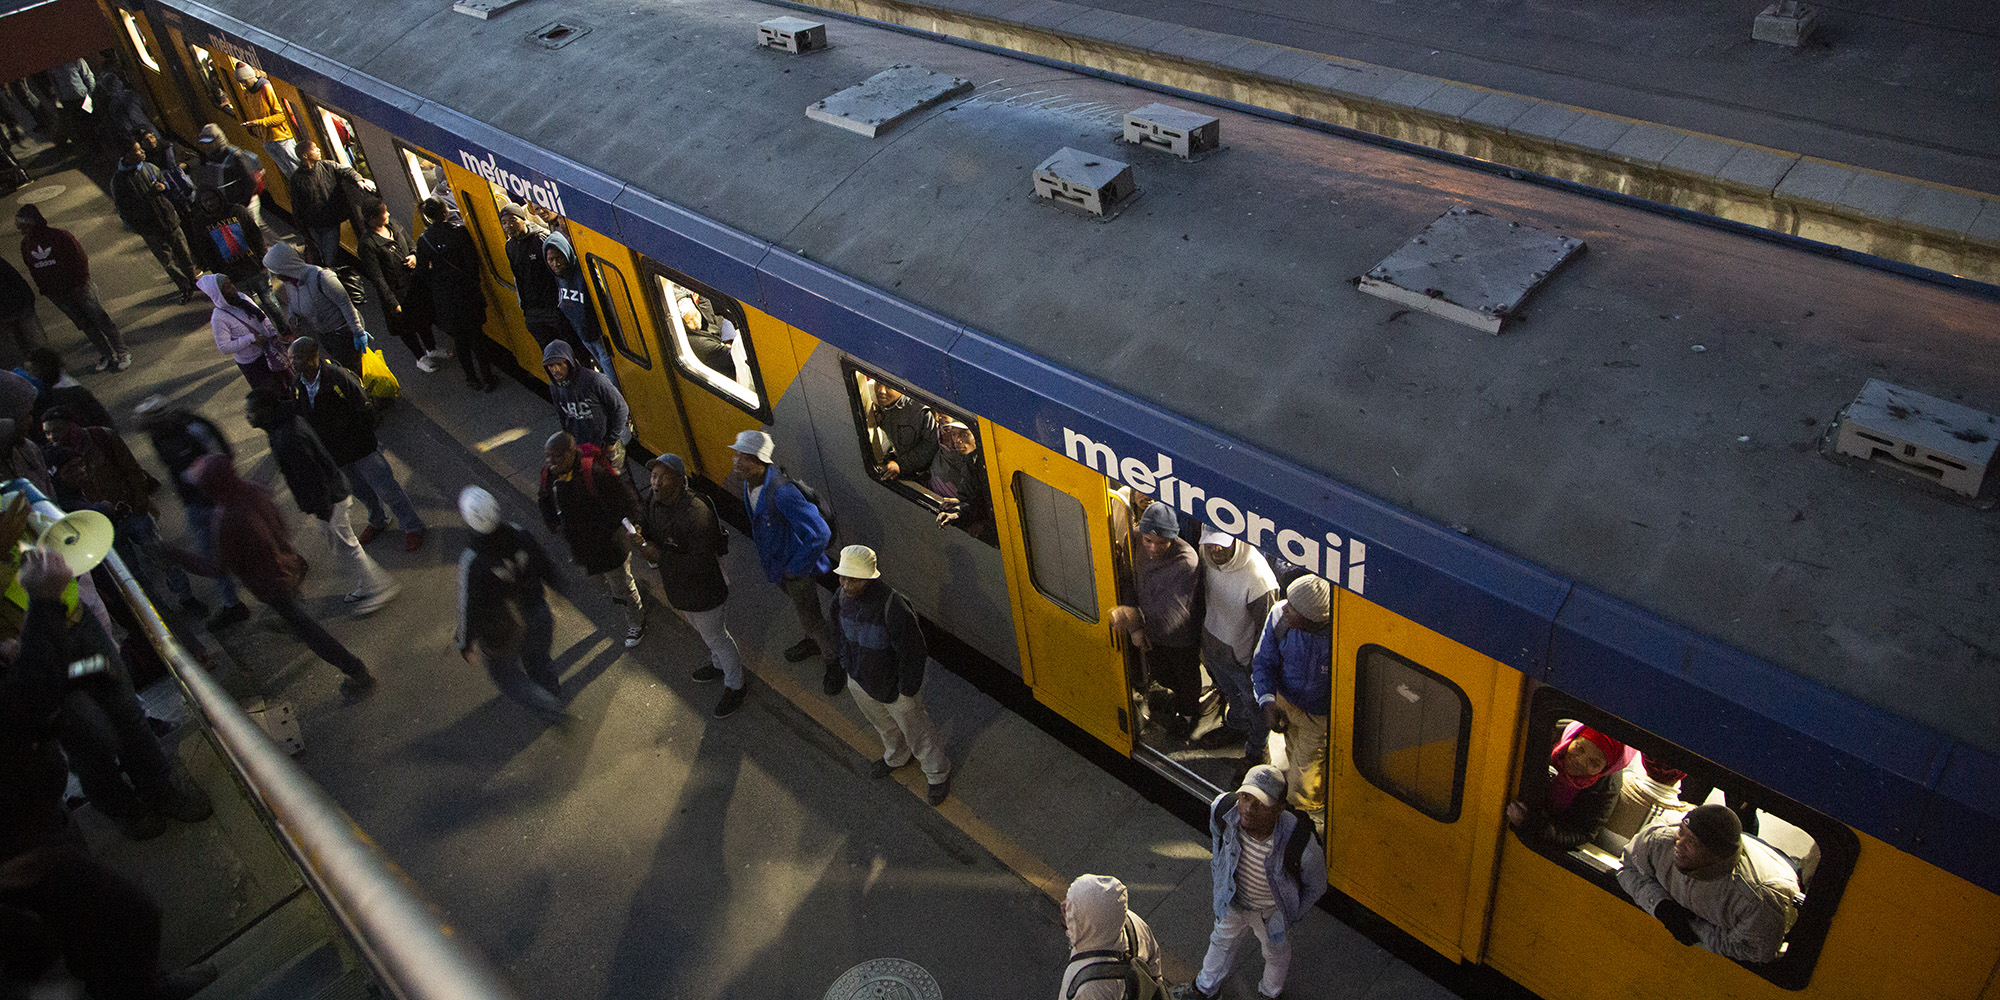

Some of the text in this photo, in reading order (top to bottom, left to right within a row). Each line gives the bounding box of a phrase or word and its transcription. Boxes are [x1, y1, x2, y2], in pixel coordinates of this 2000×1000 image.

[208, 31, 263, 71] metrorail
[458, 149, 567, 218] metrorail
[34, 259, 56, 269] adidas
[1063, 426, 1366, 595] metrorail
